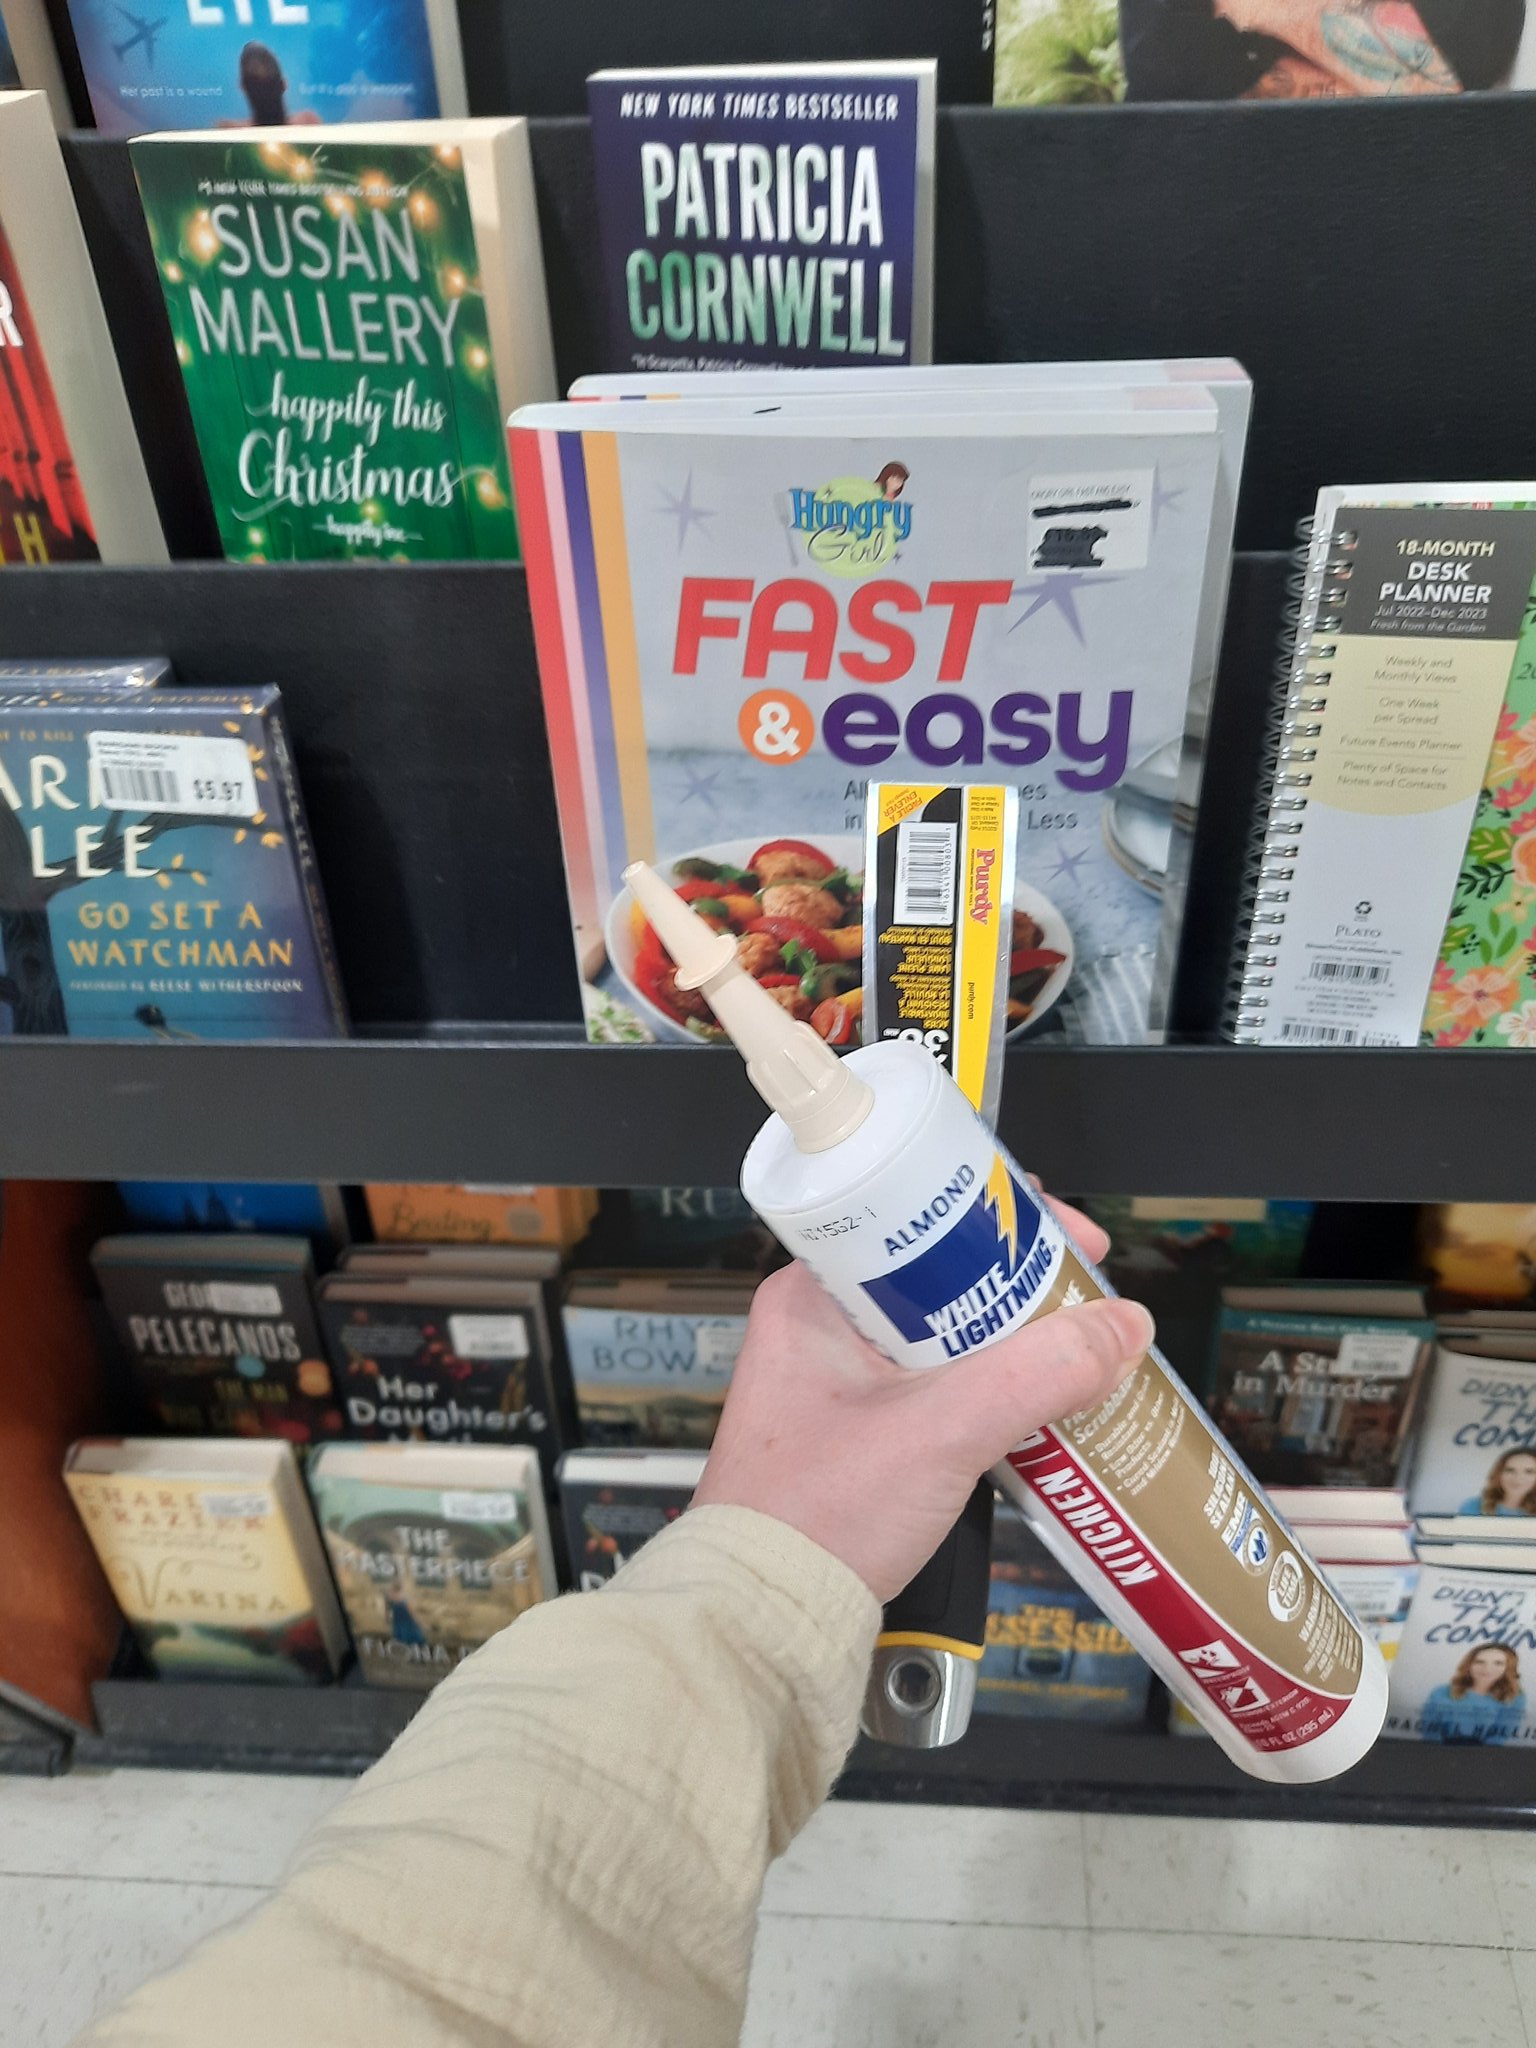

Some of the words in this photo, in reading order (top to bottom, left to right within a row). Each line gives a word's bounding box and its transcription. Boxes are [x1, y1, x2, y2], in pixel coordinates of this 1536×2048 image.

[620, 92, 661, 118] NEW
[668, 93, 716, 119] YORK
[723, 93, 779, 120] TIMES
[785, 93, 899, 121] BESTSELLER
[640, 142, 883, 247] PATRICIA
[209, 204, 421, 282] SUSAN
[625, 249, 906, 357] CORNWELL
[189, 286, 462, 367] MALLERY
[248, 370, 388, 446] happily
[391, 377, 447, 432] this
[234, 427, 458, 510] Christmas
[788, 488, 914, 543] Hungry
[807, 523, 886, 563] Girl
[1396, 538, 1496, 557] 18-MONTH
[1407, 561, 1473, 581] DESK
[1378, 582, 1493, 604] PLANNER
[1370, 619, 1398, 630] Fresh
[1400, 620, 1425, 631] from
[1427, 621, 1444, 632] the
[1447, 622, 1486, 633] Garden
[1374, 604, 1393, 618] Jul
[1457, 606, 1488, 620] 2023
[671, 576, 1015, 684] FAST
[1373, 670, 1422, 684] Monthly
[1425, 672, 1457, 683] Views
[1385, 656, 1427, 669] Weekly
[1429, 656, 1453, 668] and
[1378, 697, 1404, 708] One
[1408, 698, 1440, 709] Week
[1373, 714, 1393, 724] per
[1397, 714, 1438, 725] Spread
[752, 701, 801, 756] &
[821, 689, 1135, 793] easy
[1339, 736, 1376, 746] Future
[1379, 737, 1416, 749] Events
[1418, 739, 1462, 750] Planner
[1337, 776, 1370, 787] Notes
[1373, 777, 1394, 788] and
[1396, 778, 1447, 790] Contacts
[1342, 761, 1377, 773] Plenty
[1380, 762, 1393, 773] of
[1394, 764, 1429, 776] Space
[1431, 765, 1447, 775] for
[1026, 810, 1080, 831] Less
[30, 825, 160, 878] LEE
[970, 848, 996, 926] Purdy
[78, 901, 130, 930] GO
[150, 901, 221, 930] SET
[239, 902, 264, 930] A
[1335, 924, 1382, 938] PLATO
[67, 938, 294, 968] WATCHMAN
[149, 979, 193, 992] REESE
[198, 979, 303, 993] WITHERSPOON
[967, 982, 975, 1020] purdy.com
[883, 1164, 977, 1256] ALMOND
[923, 1261, 1010, 1334] WHITE
[940, 1237, 1054, 1358] LIGHTNING
[128, 1315, 301, 1362] PELECANOS
[1258, 1350, 1284, 1371] A
[376, 1374, 438, 1400] Her
[1233, 1370, 1263, 1392] in
[1275, 1374, 1398, 1402] Murder
[349, 1397, 547, 1434] Daughter's
[1115, 1441, 1152, 1479] Products
[1123, 1460, 1149, 1488] Cured
[396, 1525, 450, 1550] THE
[1033, 1465, 1160, 1587] KITCHEN
[334, 1547, 531, 1582] MASTERPIECE
[1021, 1603, 1075, 1620] THE
[1268, 1736, 1283, 1747] FL
[1281, 1730, 1298, 1743] OZ
